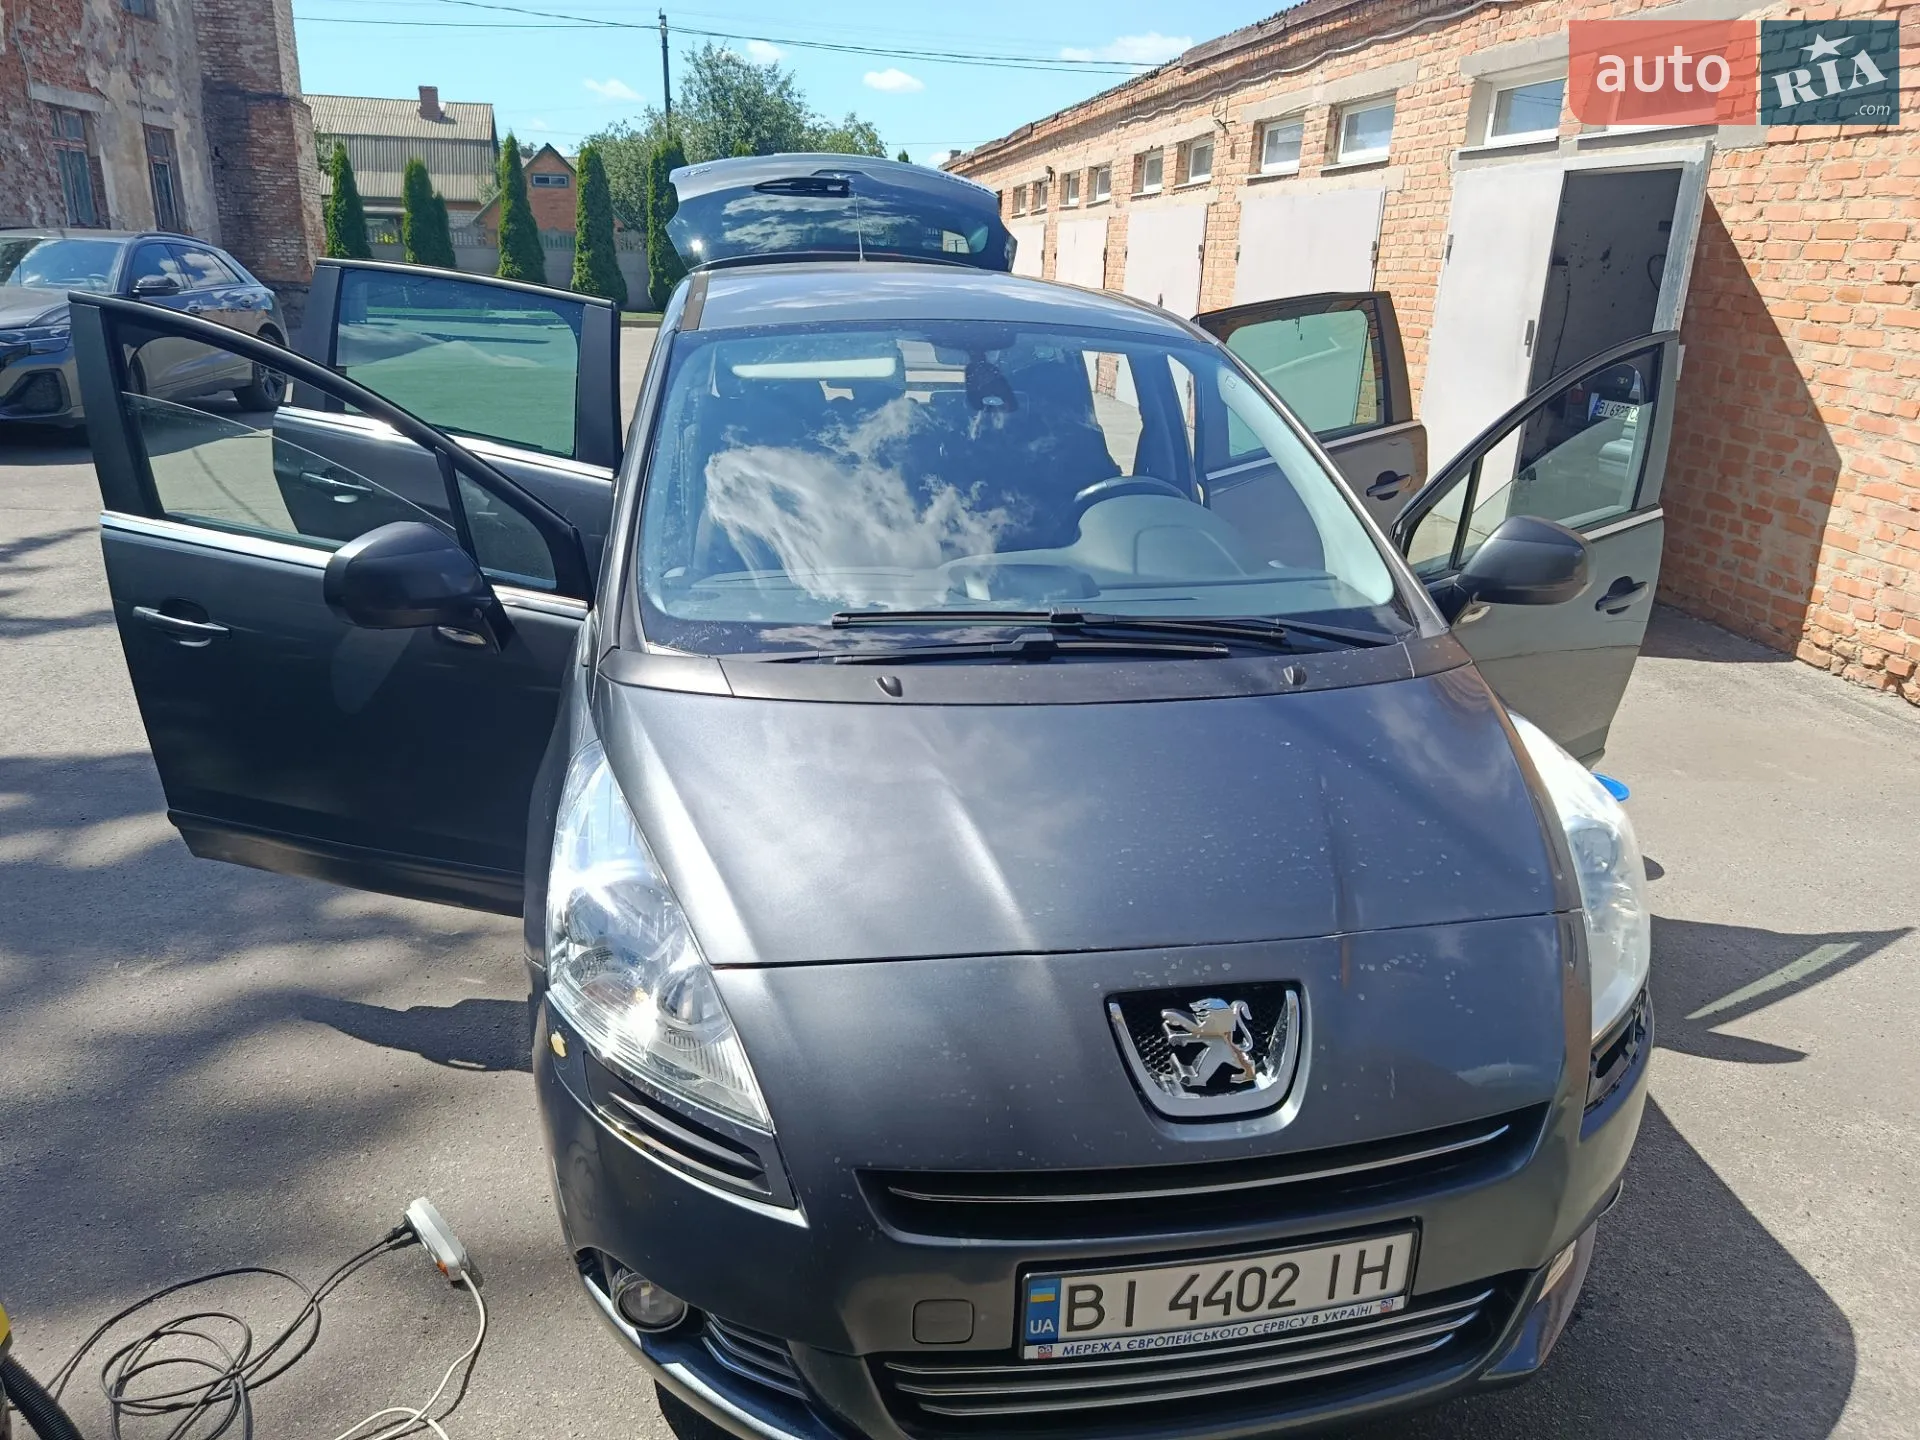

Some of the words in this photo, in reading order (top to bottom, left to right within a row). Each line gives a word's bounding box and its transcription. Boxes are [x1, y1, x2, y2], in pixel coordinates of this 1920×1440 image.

[1066, 1279, 1137, 1333] BI
[1168, 1261, 1301, 1321] 4402
[1327, 1244, 1394, 1301] IH
[1029, 1318, 1055, 1335] UA
[1062, 1340, 1121, 1357] МЕРЕЖА
[1126, 1325, 1249, 1350] ЄВРОПЕЙСЬКОГО
[1252, 1316, 1310, 1334] СЕРВІСУ
[1311, 1314, 1319, 1324] В
[1322, 1305, 1373, 1323] УКРАЇНІ
